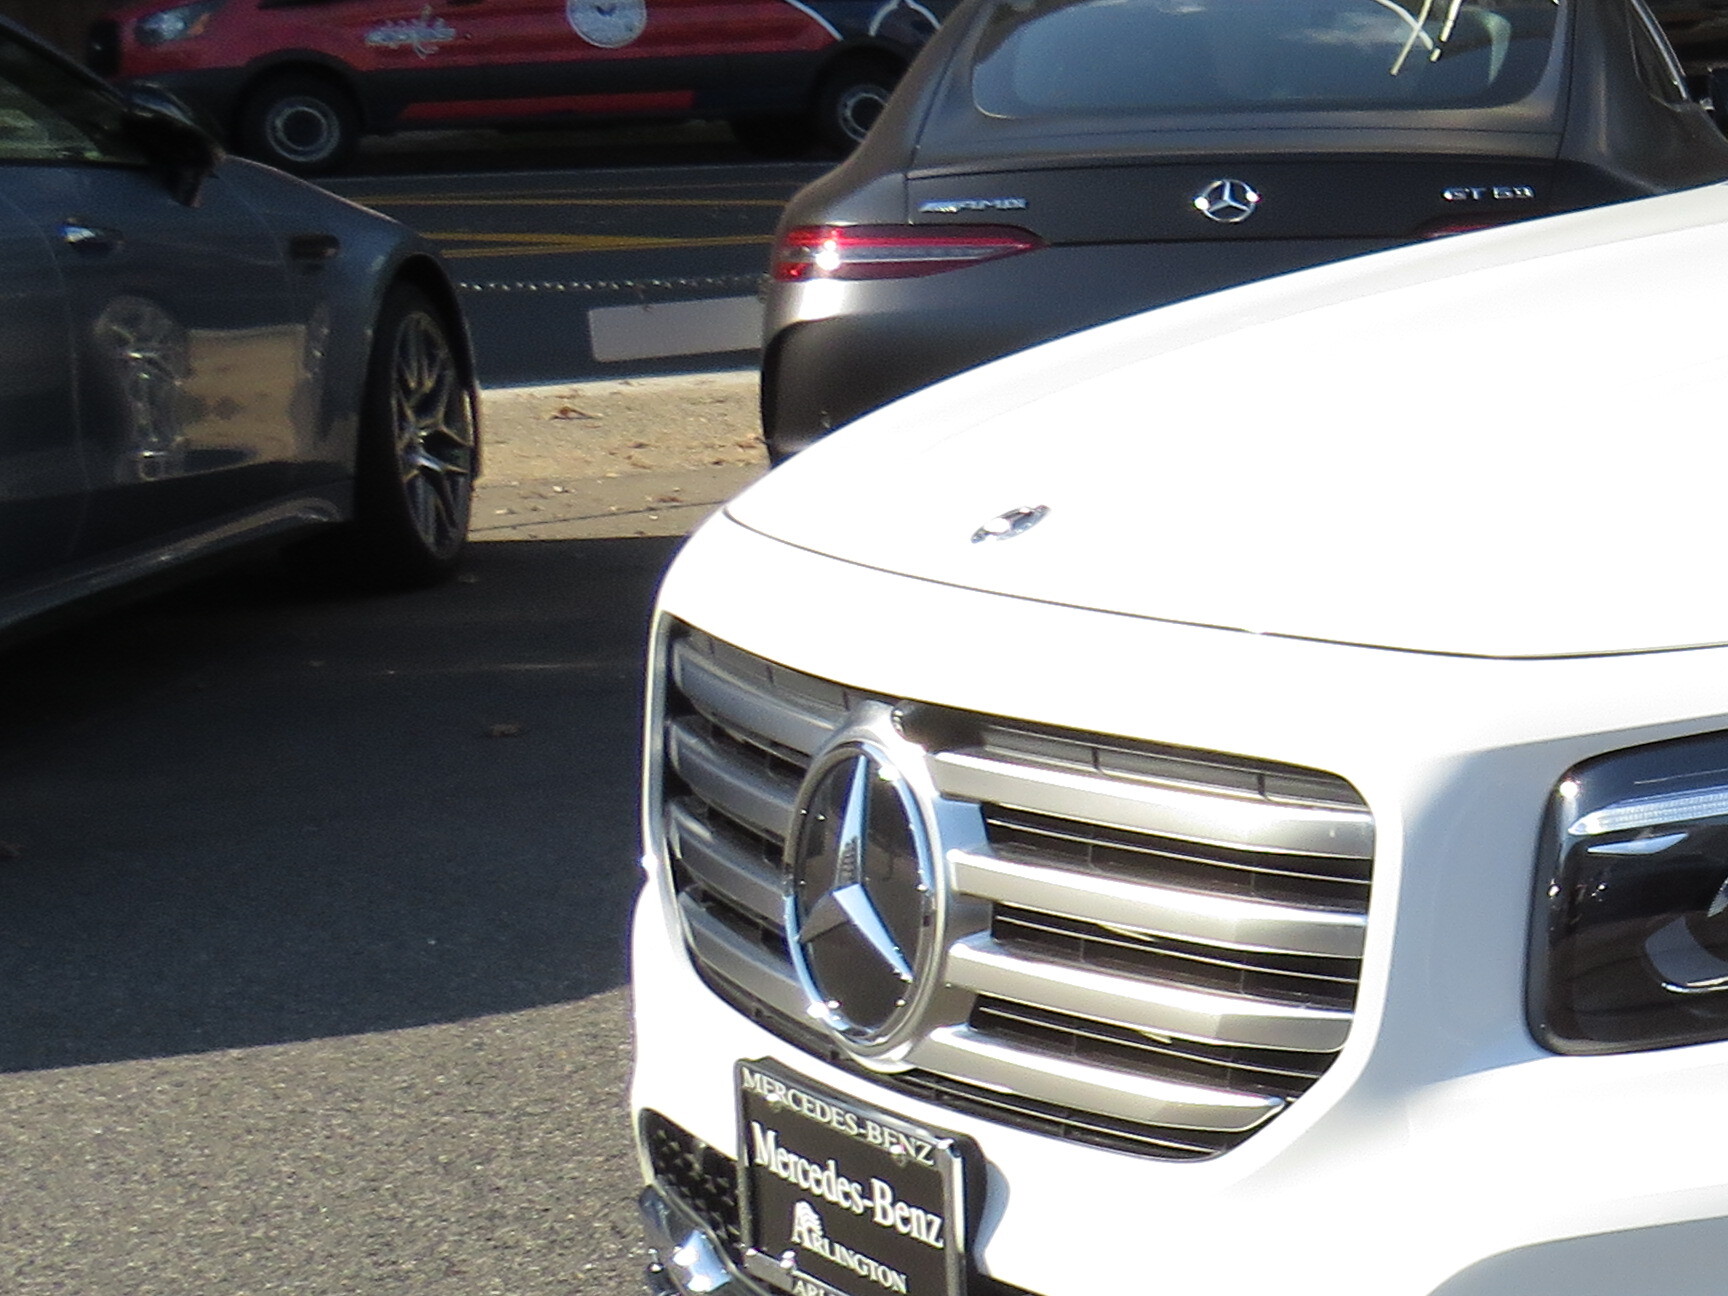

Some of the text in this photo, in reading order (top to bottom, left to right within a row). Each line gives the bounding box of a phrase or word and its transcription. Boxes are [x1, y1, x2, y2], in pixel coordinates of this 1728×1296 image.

[741, 1065, 935, 1166] MERCEDES-BENZ
[751, 1120, 945, 1249] Mercedes-Benz
[790, 1201, 908, 1295] ARLINGTON
